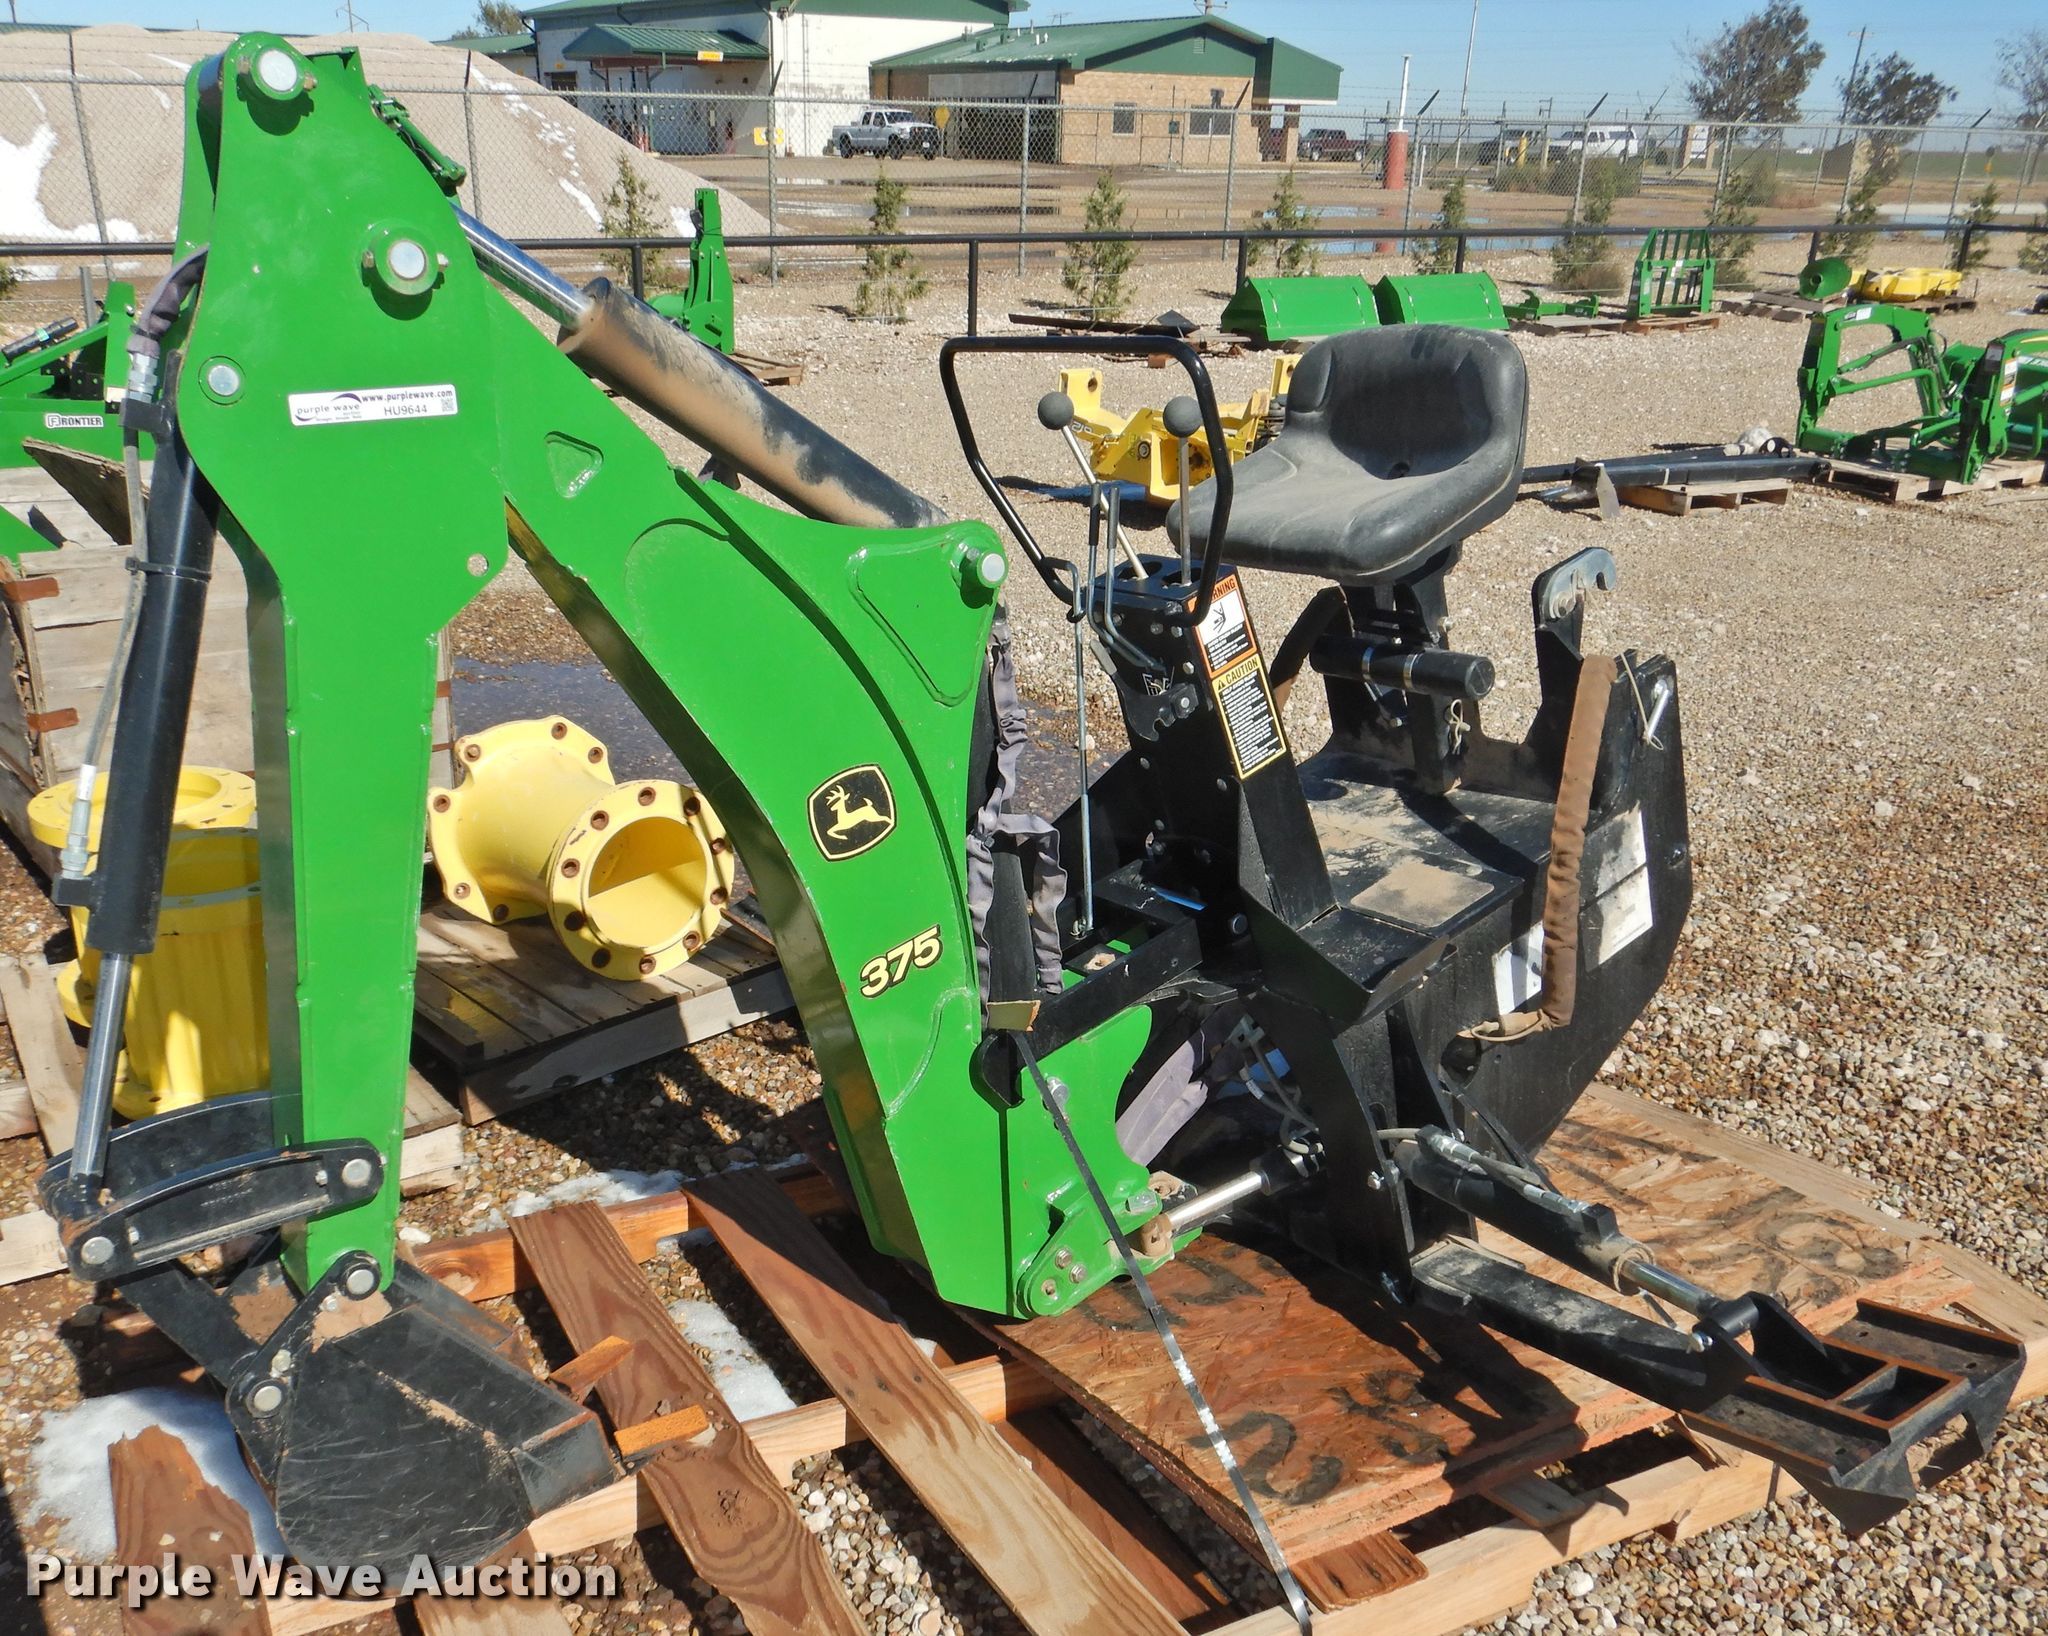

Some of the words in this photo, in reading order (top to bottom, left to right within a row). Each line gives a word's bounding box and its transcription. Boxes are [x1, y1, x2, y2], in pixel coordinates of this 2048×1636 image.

[362, 390, 453, 403] www.purplewave.com
[297, 405, 330, 415] purple
[384, 404, 428, 416] HU9644
[47, 414, 102, 427] FRONTIER
[1225, 657, 1259, 684] CAUTION
[860, 924, 943, 998] 375
